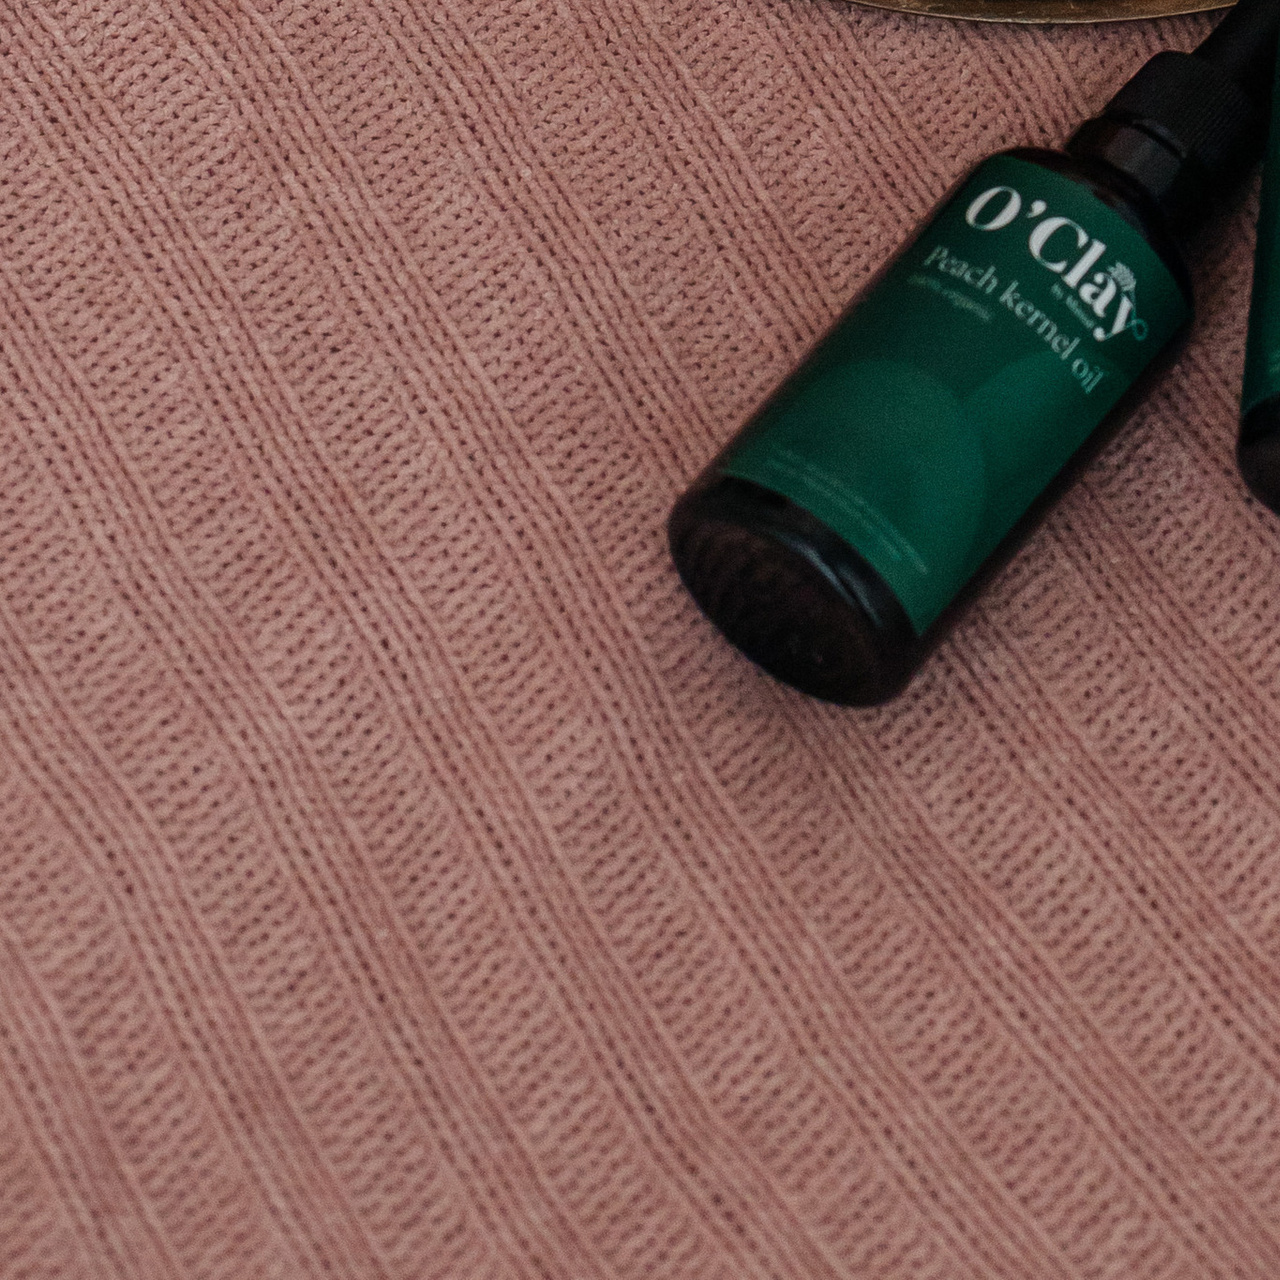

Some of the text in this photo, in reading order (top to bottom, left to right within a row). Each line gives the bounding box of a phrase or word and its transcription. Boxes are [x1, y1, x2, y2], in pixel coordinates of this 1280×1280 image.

[923, 245, 1000, 295] Peach
[999, 279, 1082, 361] kernel
[1070, 357, 1104, 395] oil
[965, 185, 1148, 341] O'Clay
